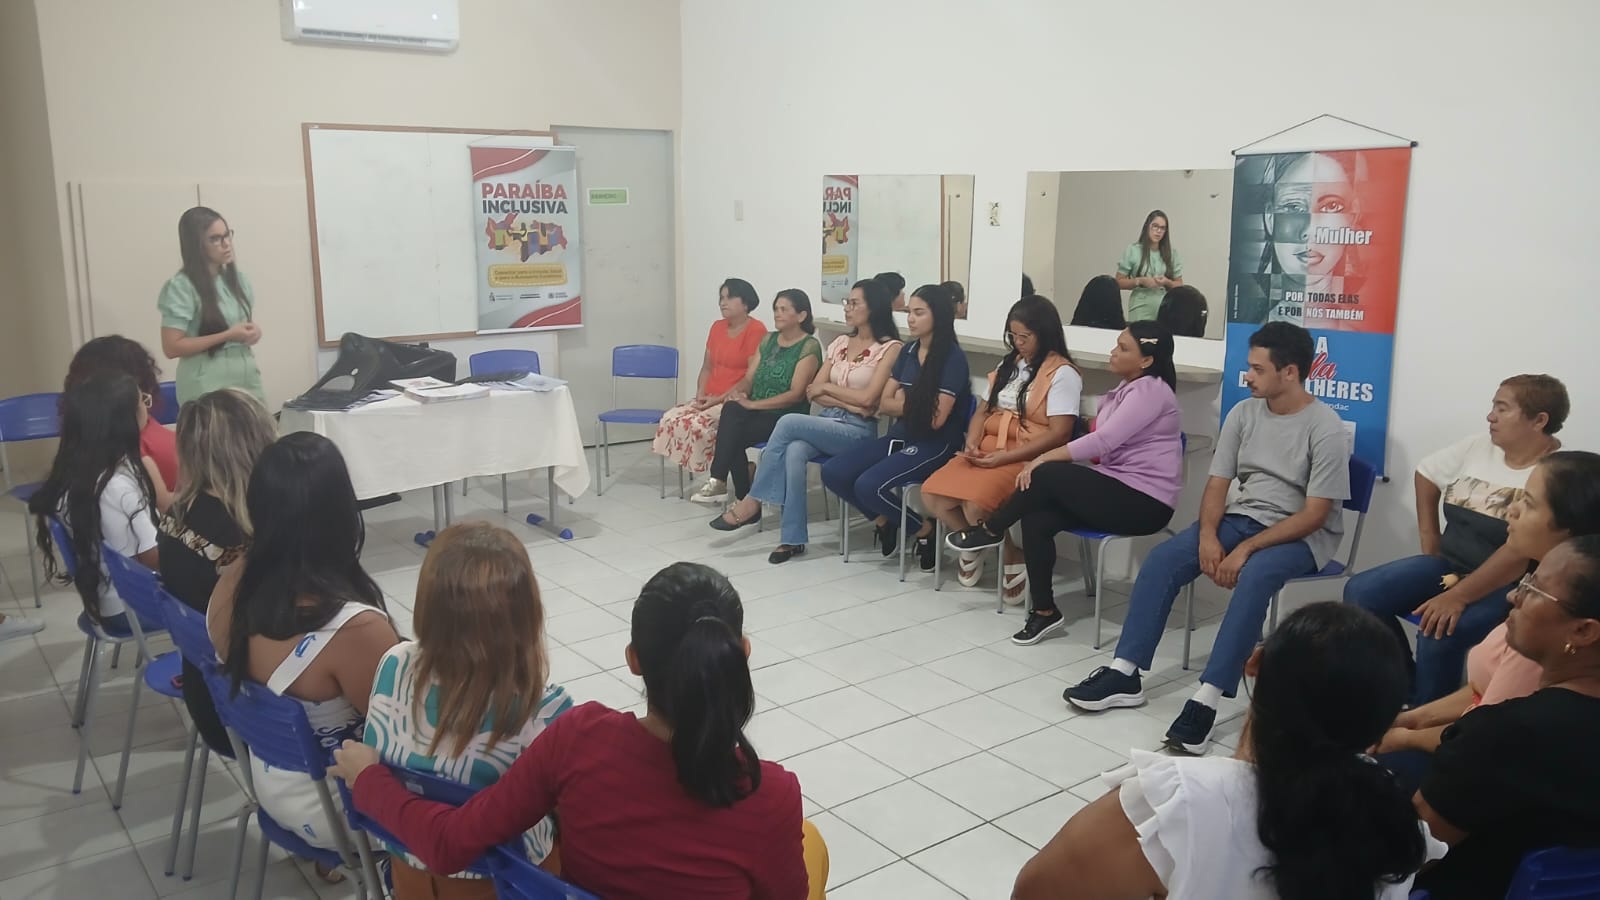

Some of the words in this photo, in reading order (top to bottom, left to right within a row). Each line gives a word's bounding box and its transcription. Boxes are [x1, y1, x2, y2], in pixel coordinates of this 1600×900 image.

[481, 180, 568, 199] PARAÍBA
[482, 200, 568, 214] INCLUSIVA
[1316, 227, 1373, 245] Mulher
[1285, 291, 1304, 302] POR
[1308, 292, 1336, 303] TODAS
[1338, 294, 1359, 304] ELAS
[1278, 307, 1284, 316] E
[1285, 307, 1302, 316] POR
[1326, 308, 1364, 320] TAMBÉM
[1304, 378, 1374, 402] LHERES
